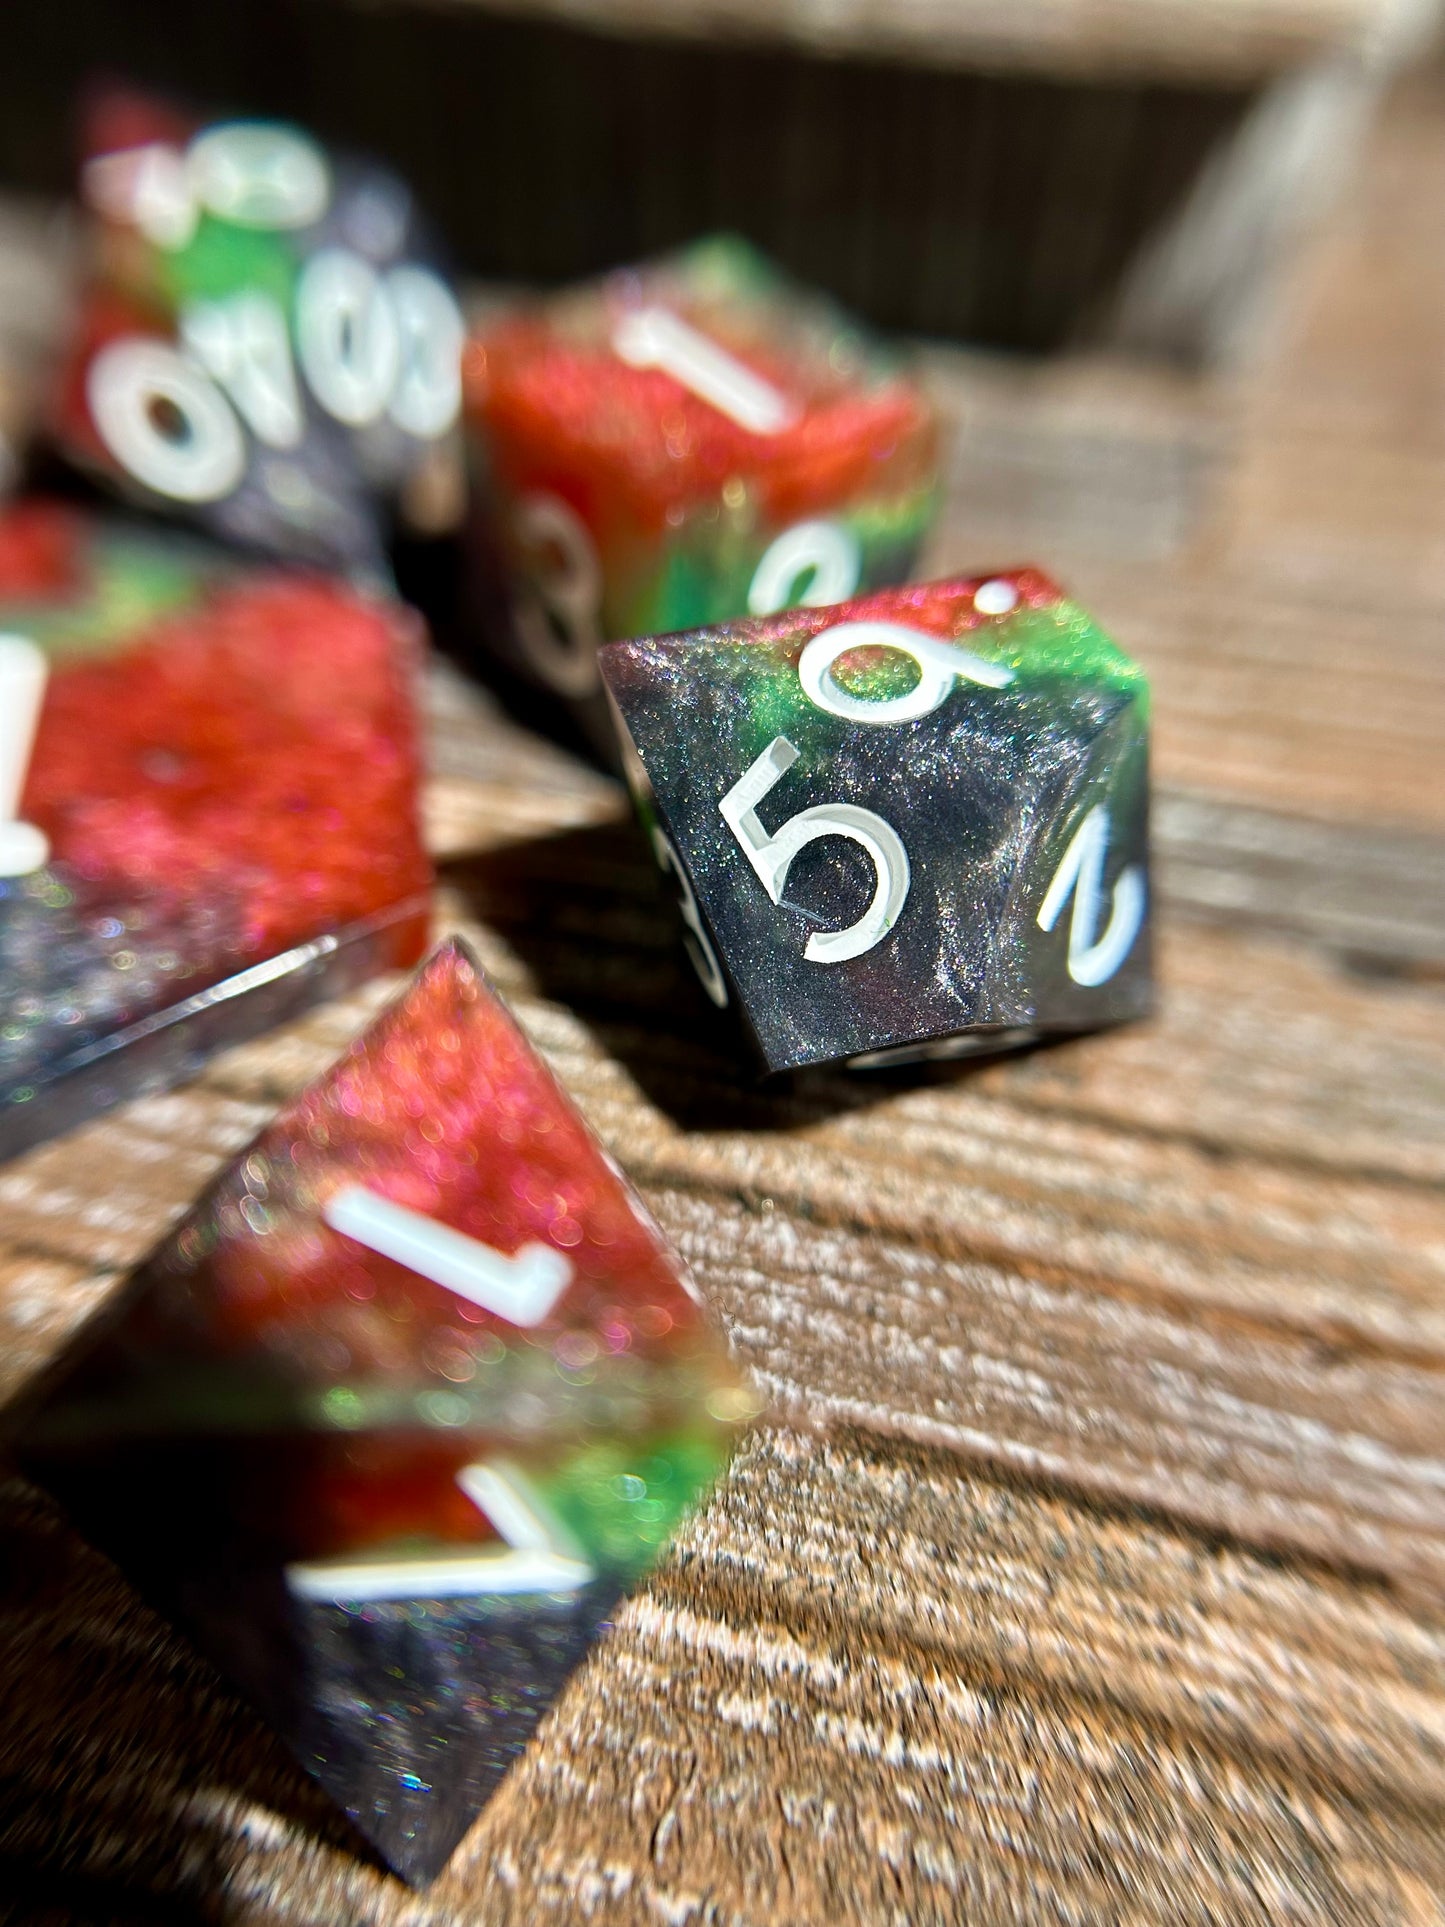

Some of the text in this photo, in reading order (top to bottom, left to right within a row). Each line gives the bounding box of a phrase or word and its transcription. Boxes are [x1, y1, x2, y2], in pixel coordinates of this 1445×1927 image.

[613, 308, 787, 434] 1
[719, 735, 911, 964] 5
[1036, 803, 1146, 987] 2
[324, 1185, 574, 1327] 1
